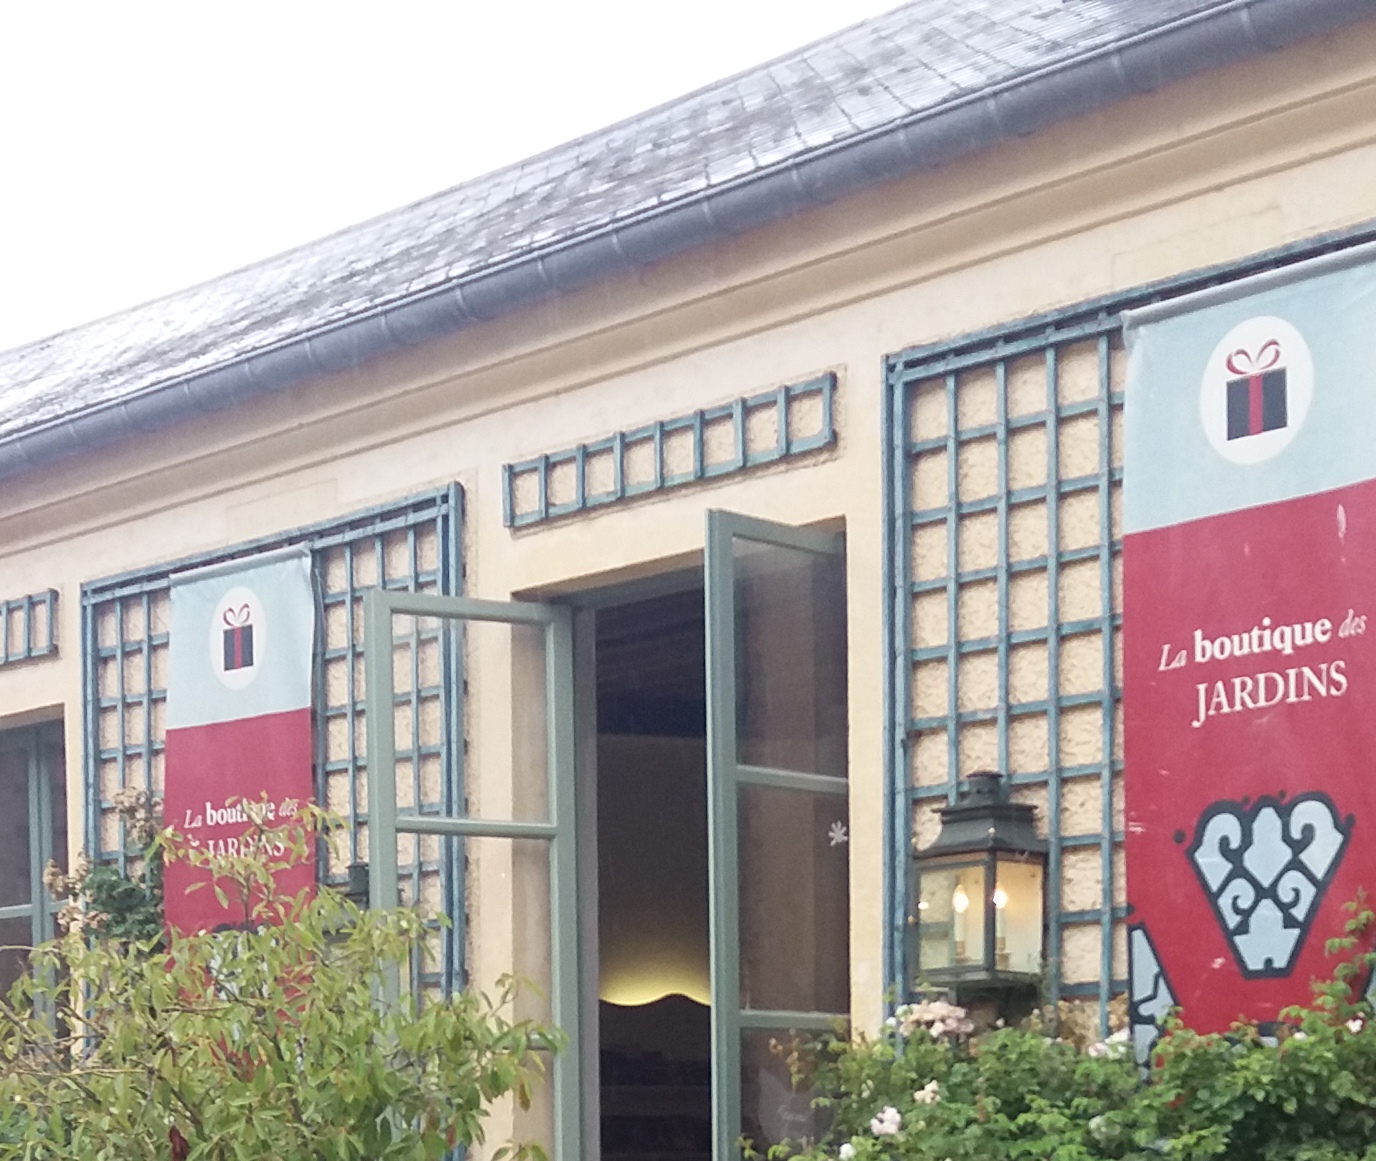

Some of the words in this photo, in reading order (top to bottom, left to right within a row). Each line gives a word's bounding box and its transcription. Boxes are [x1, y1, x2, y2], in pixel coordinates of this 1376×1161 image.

[1158, 644, 1187, 671] La
[1193, 617, 1332, 663] boutique
[1337, 608, 1368, 638] des
[1191, 660, 1348, 728] JARDINS
[184, 809, 202, 829] La
[205, 801, 275, 825] boute
[206, 834, 285, 859] JARNS
